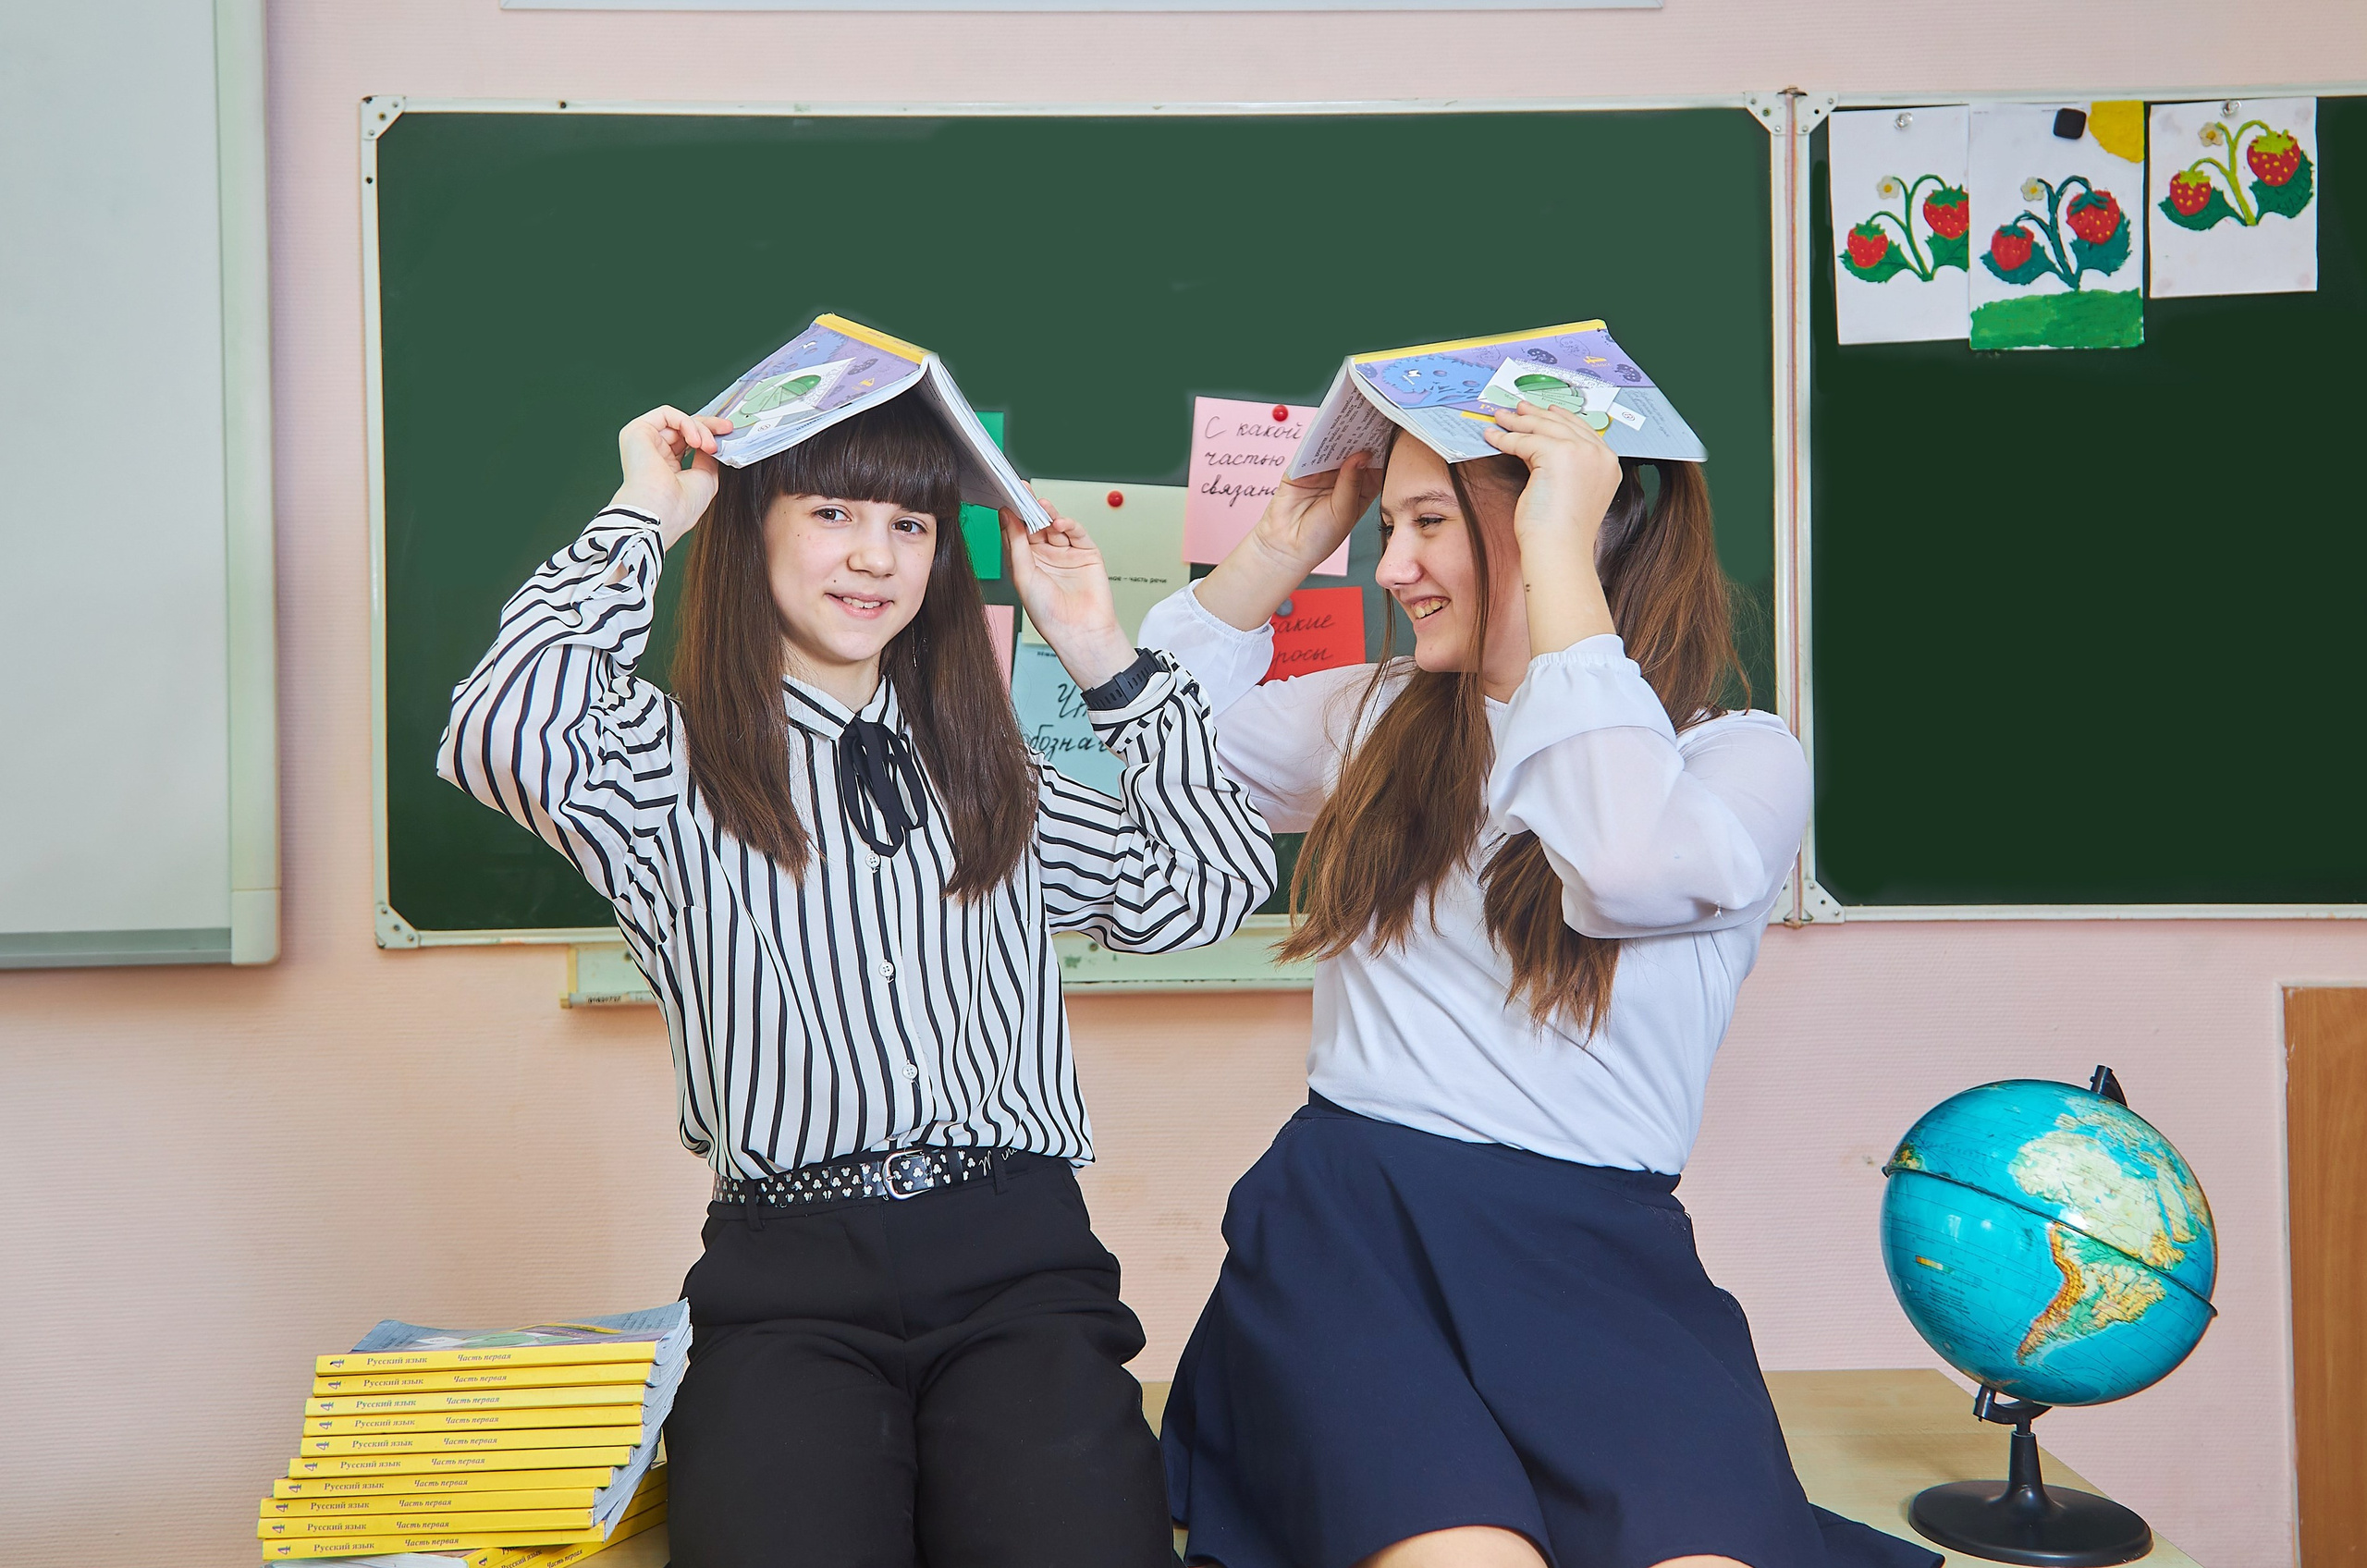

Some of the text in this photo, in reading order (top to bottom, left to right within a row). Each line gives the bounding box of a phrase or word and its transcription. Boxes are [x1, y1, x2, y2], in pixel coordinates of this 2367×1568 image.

[1205, 416, 1302, 439] С какой
[1204, 451, 1285, 466] частью
[1272, 614, 1335, 633] акие
[1272, 648, 1333, 677] росы
[366, 1356, 403, 1366] Русский
[363, 1378, 399, 1388] Русский
[479, 1375, 508, 1383] первая
[356, 1400, 392, 1409] Русский
[354, 1419, 391, 1428] Русский
[352, 1439, 388, 1450] Русский
[340, 1461, 376, 1470] Русский
[324, 1482, 361, 1492] Русский
[414, 1479, 439, 1488] Часть
[440, 1479, 468, 1488] первая
[311, 1501, 346, 1511] Русский
[307, 1523, 343, 1532] Русский
[313, 1543, 350, 1552] Русский
[432, 1538, 459, 1547] первая
